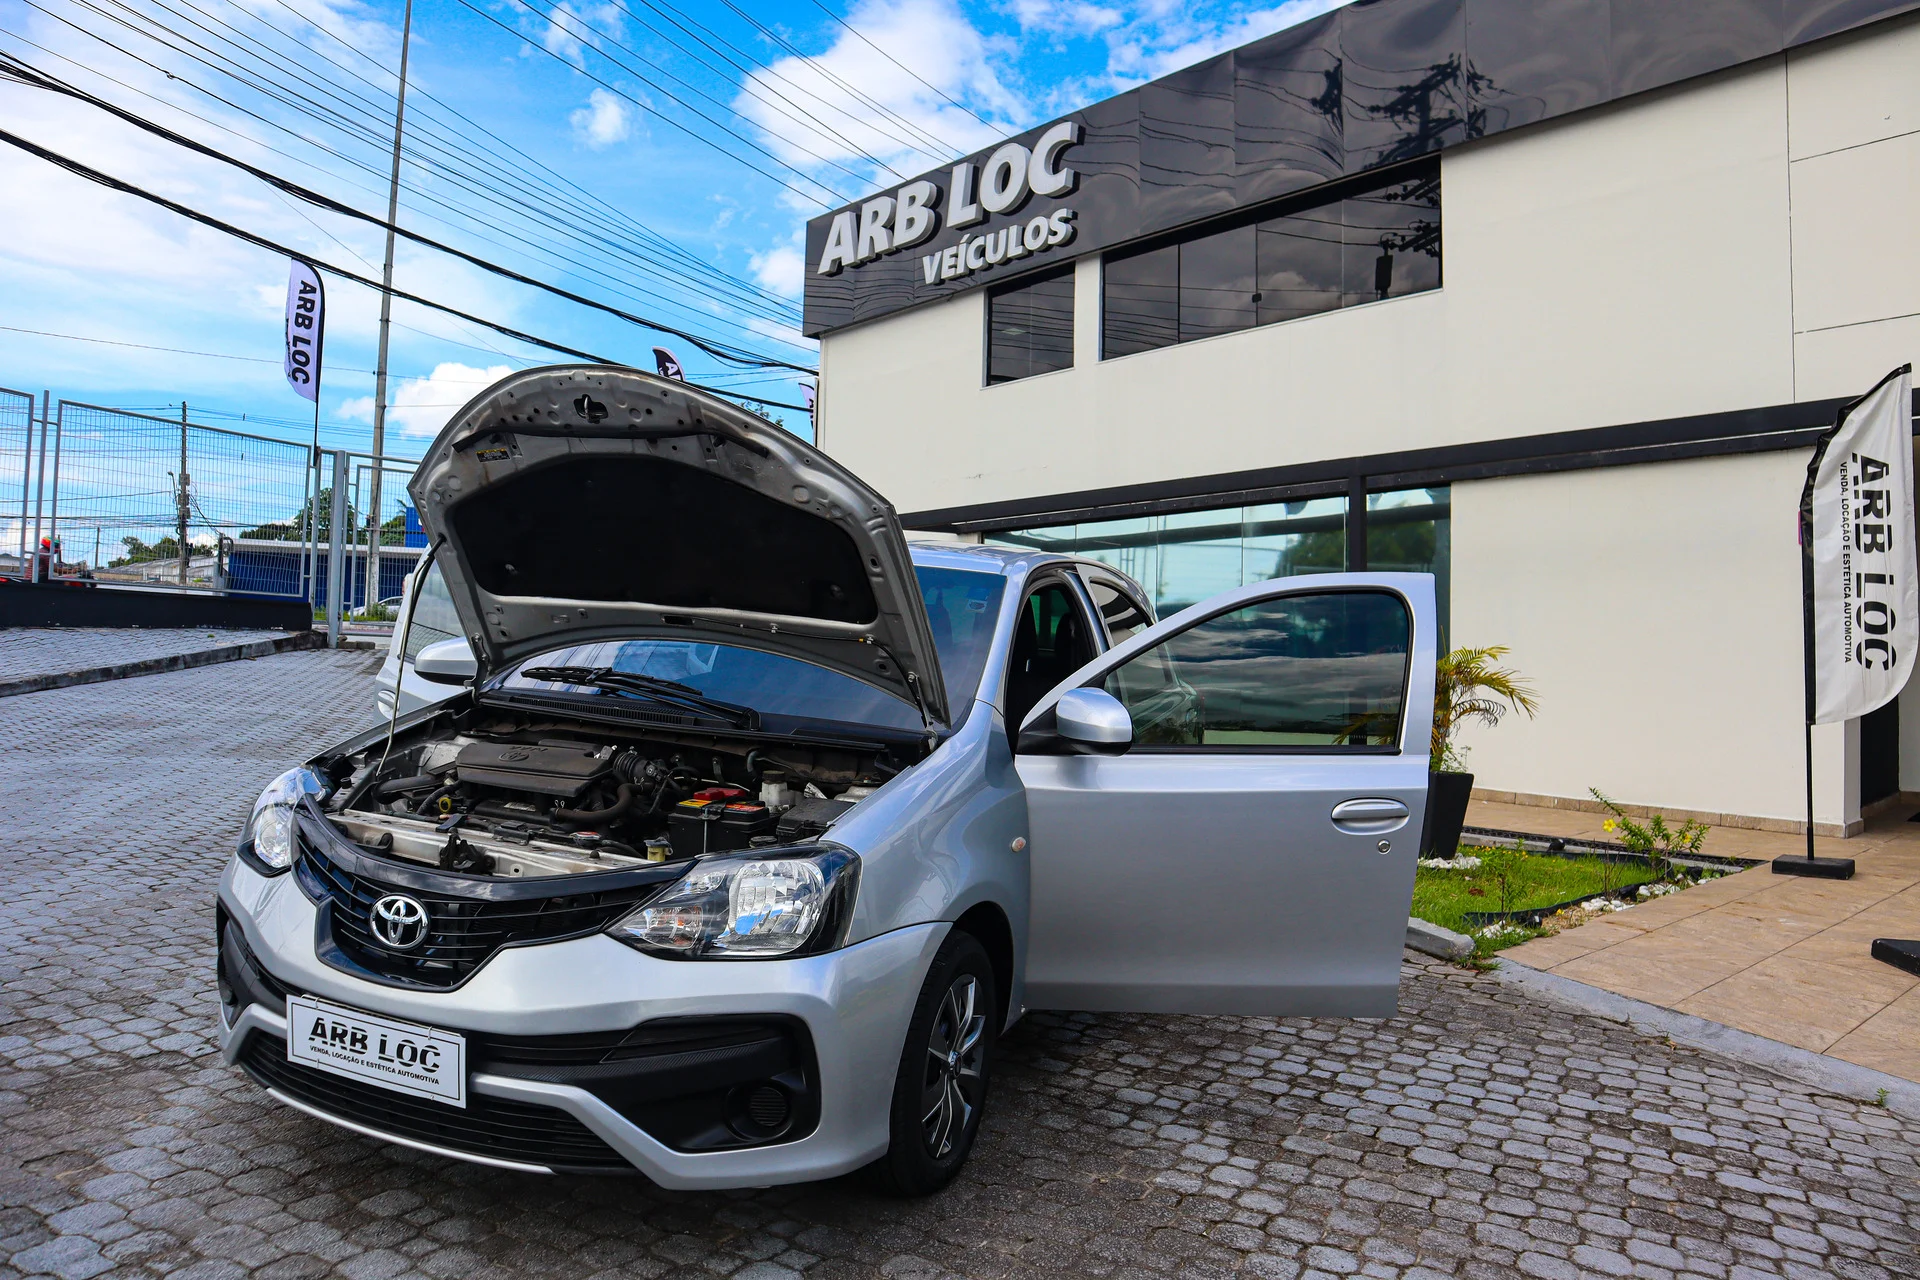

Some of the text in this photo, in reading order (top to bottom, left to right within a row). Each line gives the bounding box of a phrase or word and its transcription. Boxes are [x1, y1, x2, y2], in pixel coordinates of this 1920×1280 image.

[817, 121, 1080, 275] ARB LOC
[922, 208, 1074, 285] VEÍCULOS
[291, 279, 317, 385] ARB LOC
[1840, 461, 1849, 496] VENDA,
[1841, 498, 1851, 542] LOCAÇÃO
[1843, 553, 1852, 599] ESTÉTICA
[1851, 452, 1897, 671] ARB LOC
[1844, 601, 1852, 663] AUTOMOTIVA
[308, 1017, 441, 1074] ARB LOC
[309, 1045, 331, 1058] VENDA,
[331, 1051, 360, 1065] LOCAÇÃO
[366, 1060, 397, 1075] ESTÉTICA
[397, 1069, 440, 1086] AUTOMOTIVA
